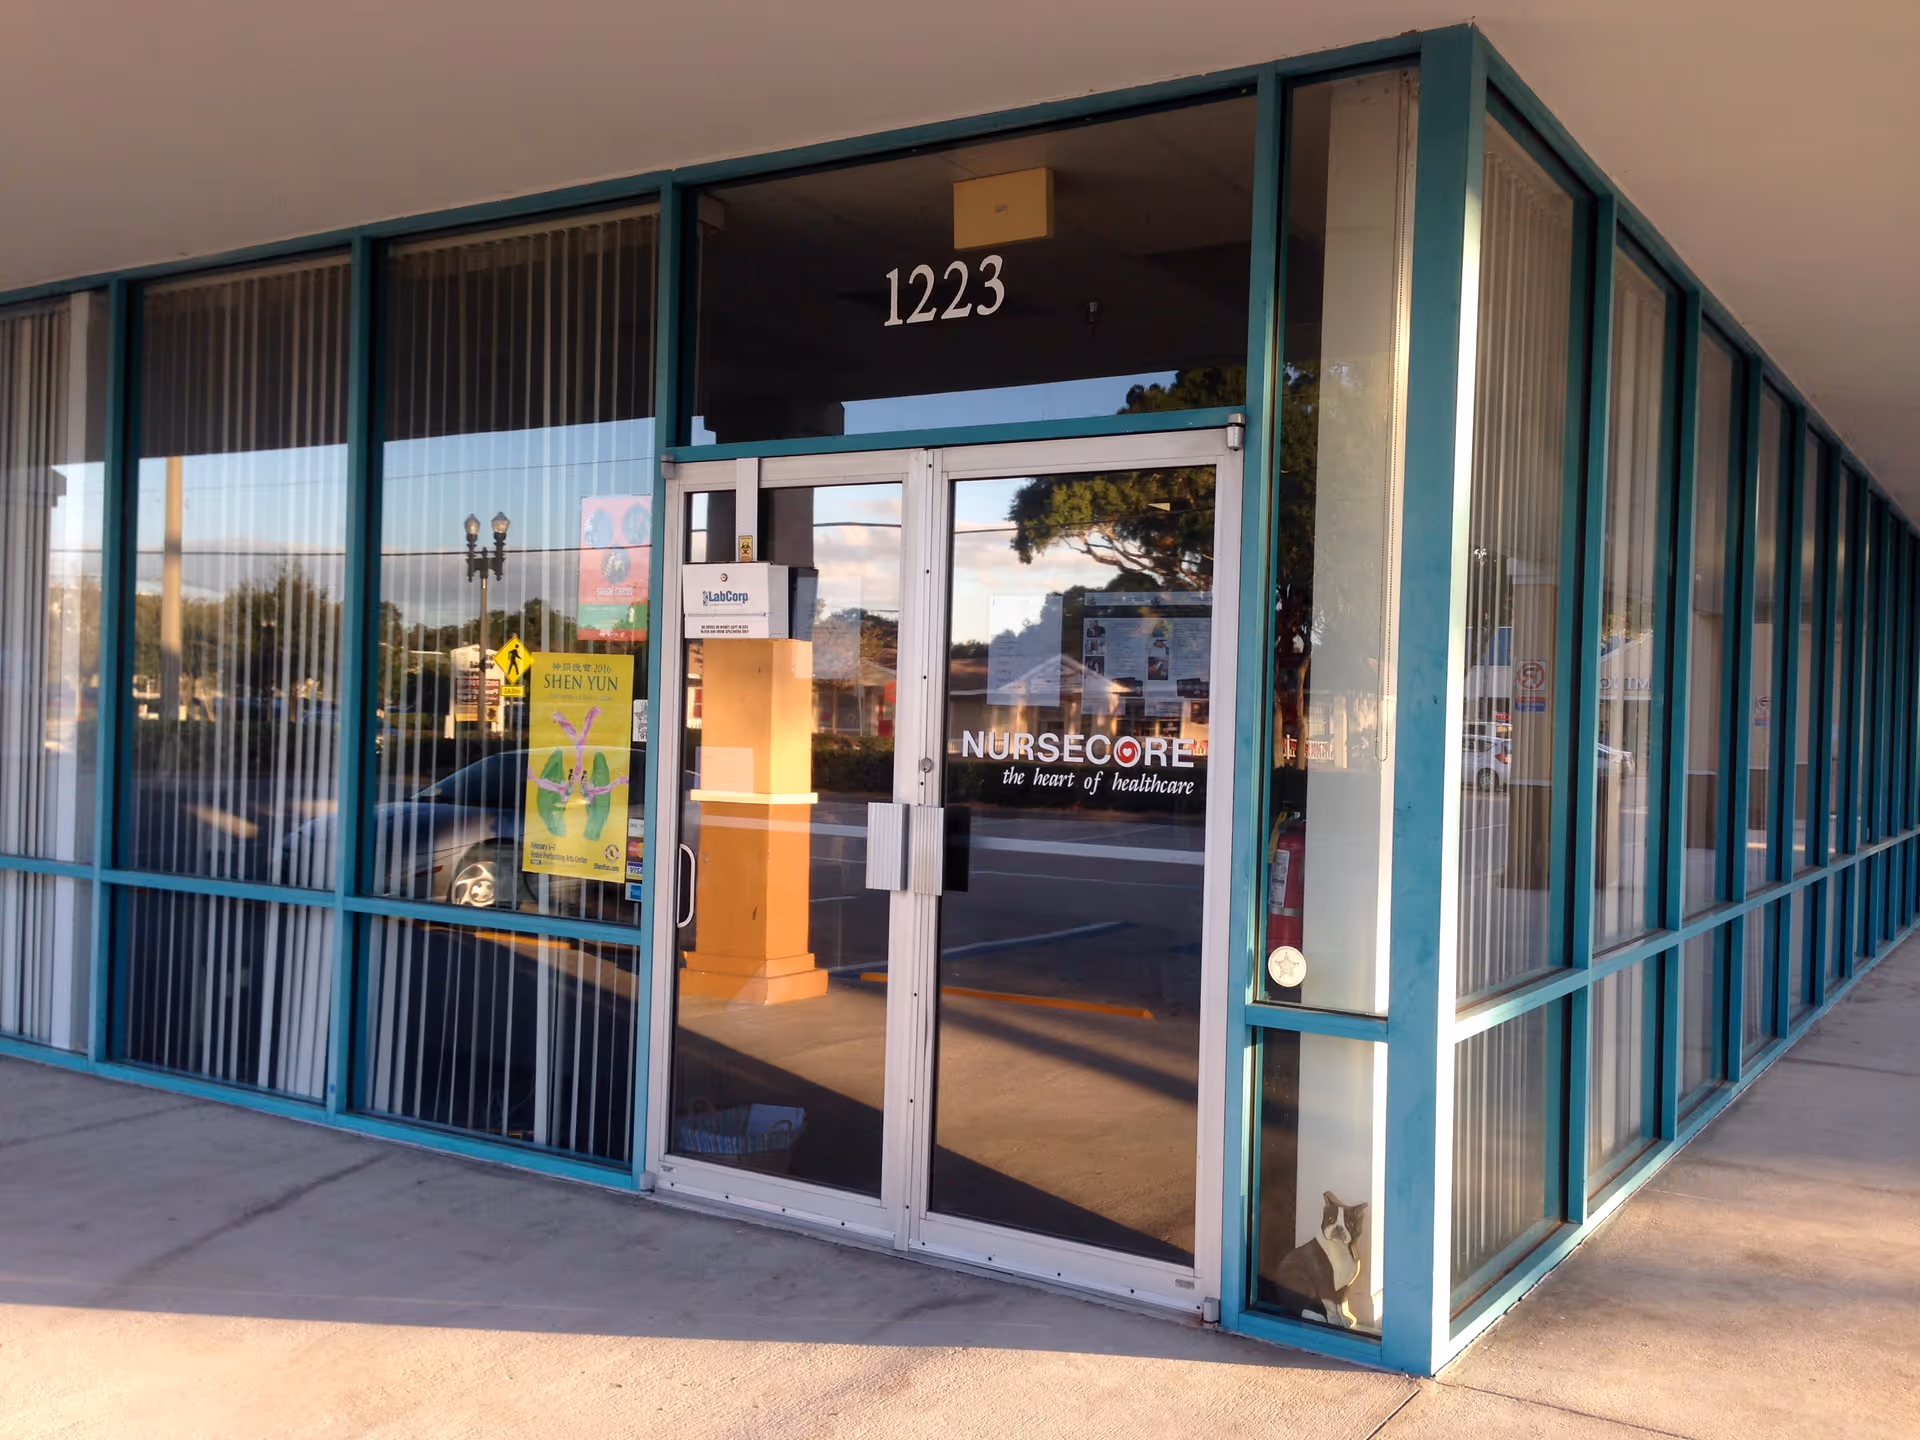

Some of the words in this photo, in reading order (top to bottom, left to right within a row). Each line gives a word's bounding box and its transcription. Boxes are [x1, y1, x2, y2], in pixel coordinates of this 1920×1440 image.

[884, 254, 1005, 326] 1223
[708, 590, 748, 604] LabCorp
[593, 664, 612, 674] 2016
[544, 674, 583, 690] SHEN
[587, 676, 618, 691] YUN
[961, 730, 1195, 768] NURSECORE
[1002, 766, 1025, 785] the
[1033, 767, 1075, 788] heart
[1084, 770, 1104, 795] of
[1112, 772, 1194, 795] healthcare
